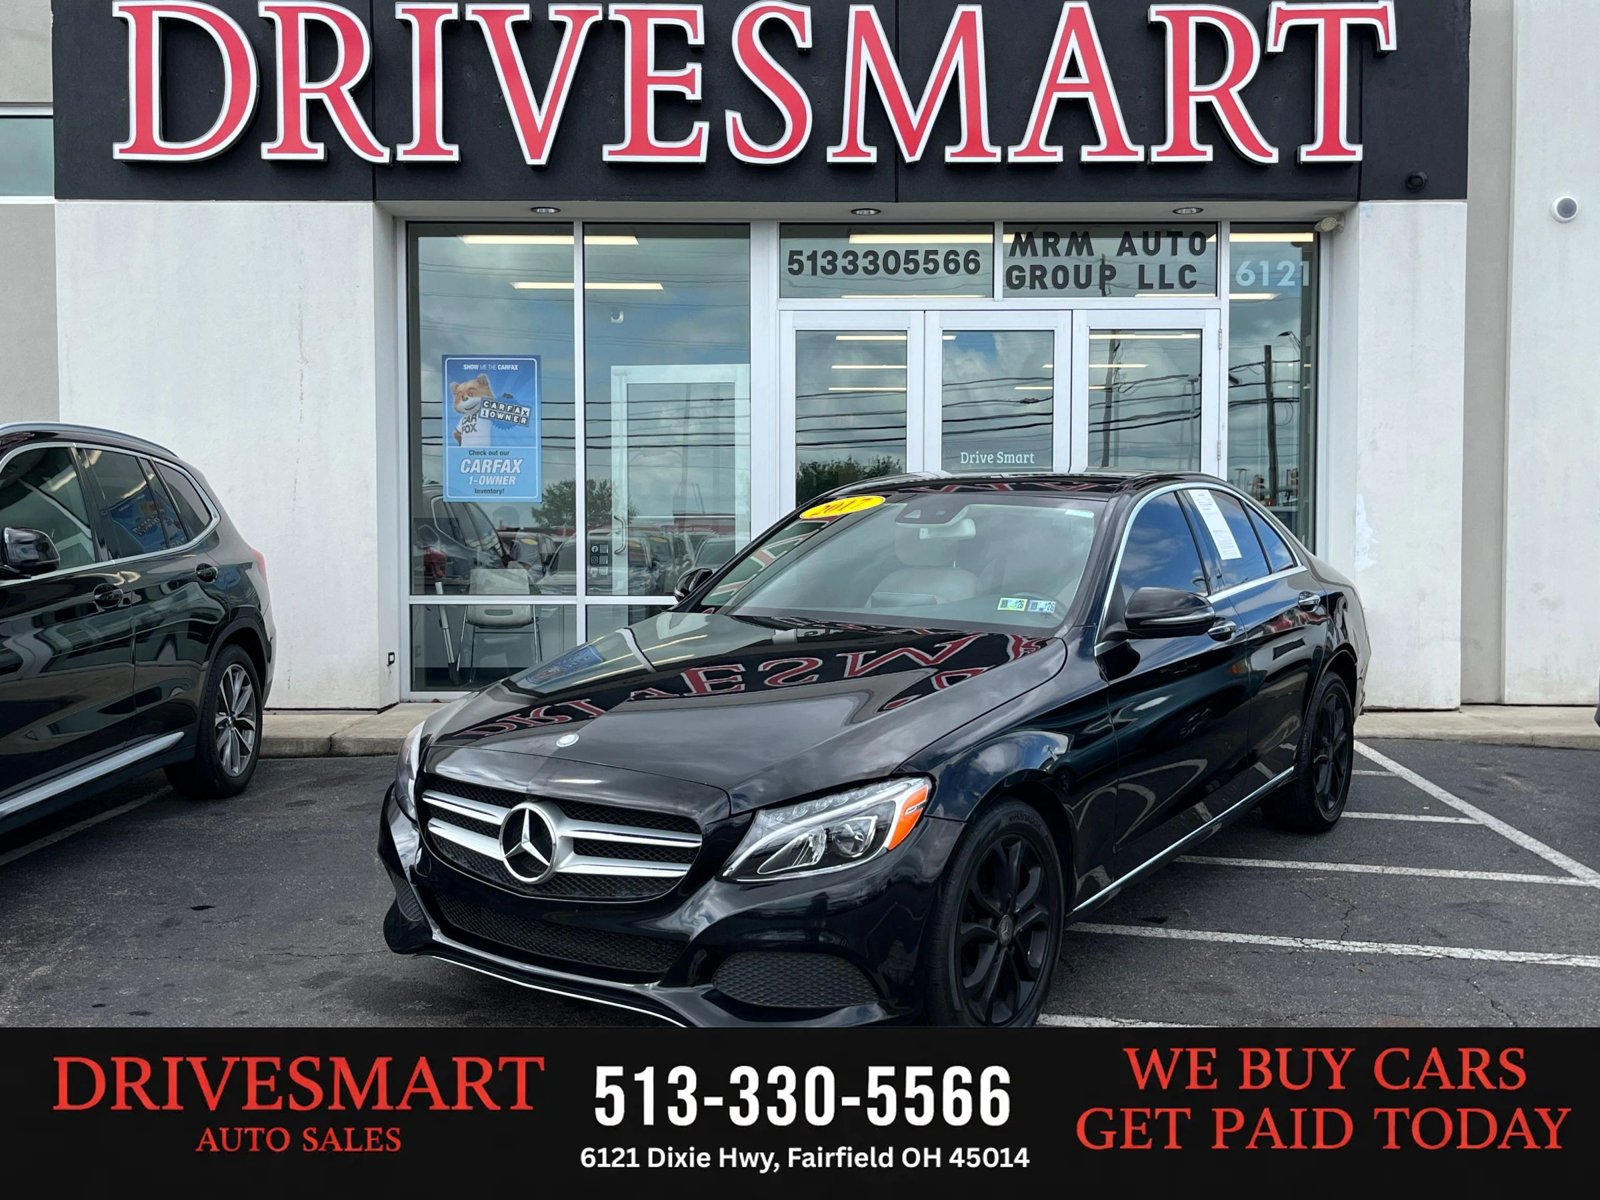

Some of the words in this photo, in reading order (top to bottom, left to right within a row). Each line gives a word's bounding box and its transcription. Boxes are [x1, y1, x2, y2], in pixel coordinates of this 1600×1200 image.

[112, 0, 1397, 165] DRIVESMART
[1009, 231, 1094, 257] MRM
[1116, 231, 1207, 257] AUTO
[787, 249, 981, 277] 5133305566
[1005, 264, 1117, 290] GROUP
[1138, 264, 1197, 290] LLC
[1236, 260, 1310, 287] 6121
[463, 363, 479, 371] SHOW
[497, 363, 519, 371] CARFAX
[483, 400, 529, 417] CARFAX
[461, 413, 477, 426] CAR
[489, 411, 528, 425] OWNER
[461, 423, 478, 434] FOX
[960, 451, 994, 464] Drive
[996, 451, 1035, 464] Smart
[460, 458, 523, 474] CARFAX
[469, 475, 517, 485] 1-OWNER
